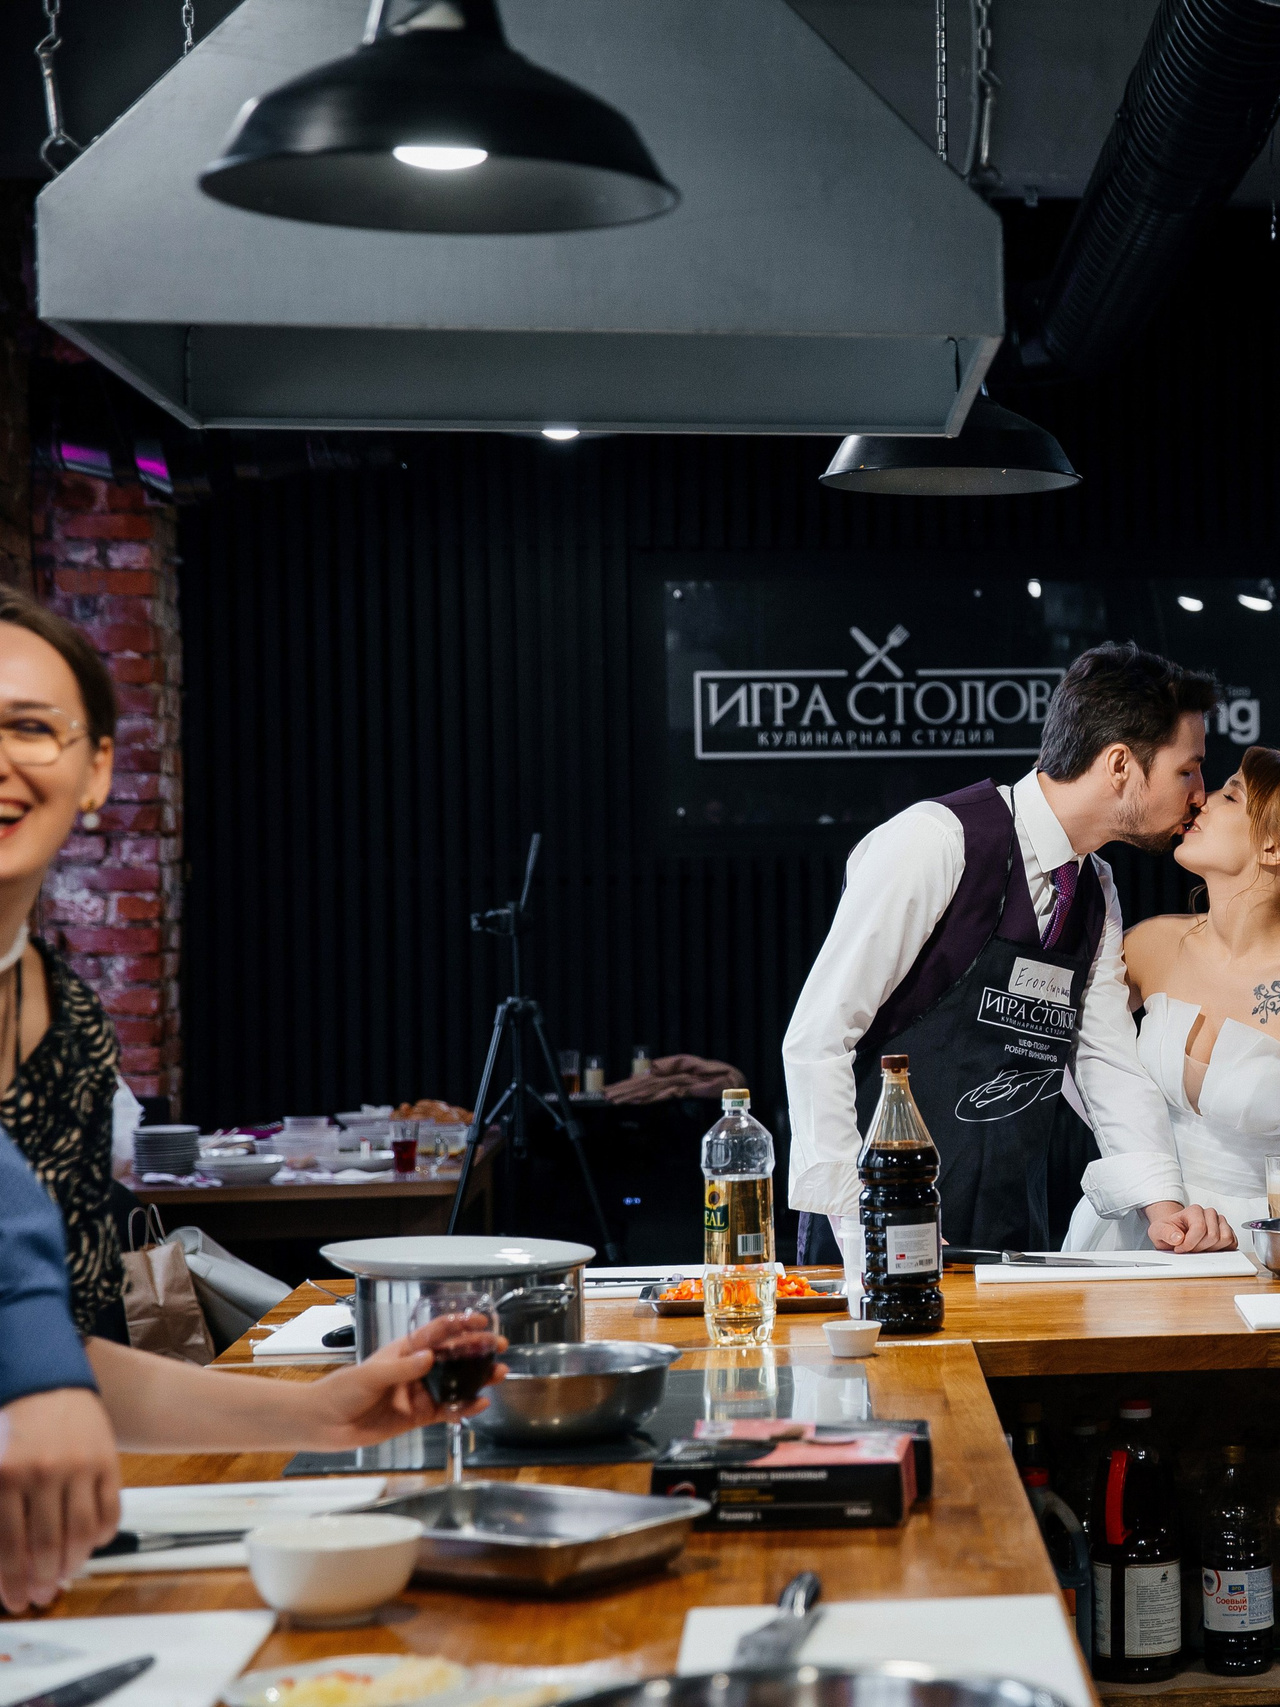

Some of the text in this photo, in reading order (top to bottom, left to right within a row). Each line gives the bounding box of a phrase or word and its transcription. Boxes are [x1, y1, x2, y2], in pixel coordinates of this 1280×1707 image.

[707, 679, 1052, 728] ИГРА СТОЛОВ
[758, 730, 996, 748] КУЛИНАРНАЯ СТУДИЯ
[985, 992, 1074, 1030] ИГРА СТОЛОВ
[1000, 1015, 1043, 1032] КУЛИНАРНАЯ
[1018, 1038, 1051, 1051] ШЕФ-ПОВАР
[1004, 1044, 1058, 1063] РОБЕРТ ВИНОКУРОВ
[704, 1210, 725, 1227] EAL
[1215, 1596, 1248, 1605] Соевый
[1228, 1605, 1248, 1613] соус
